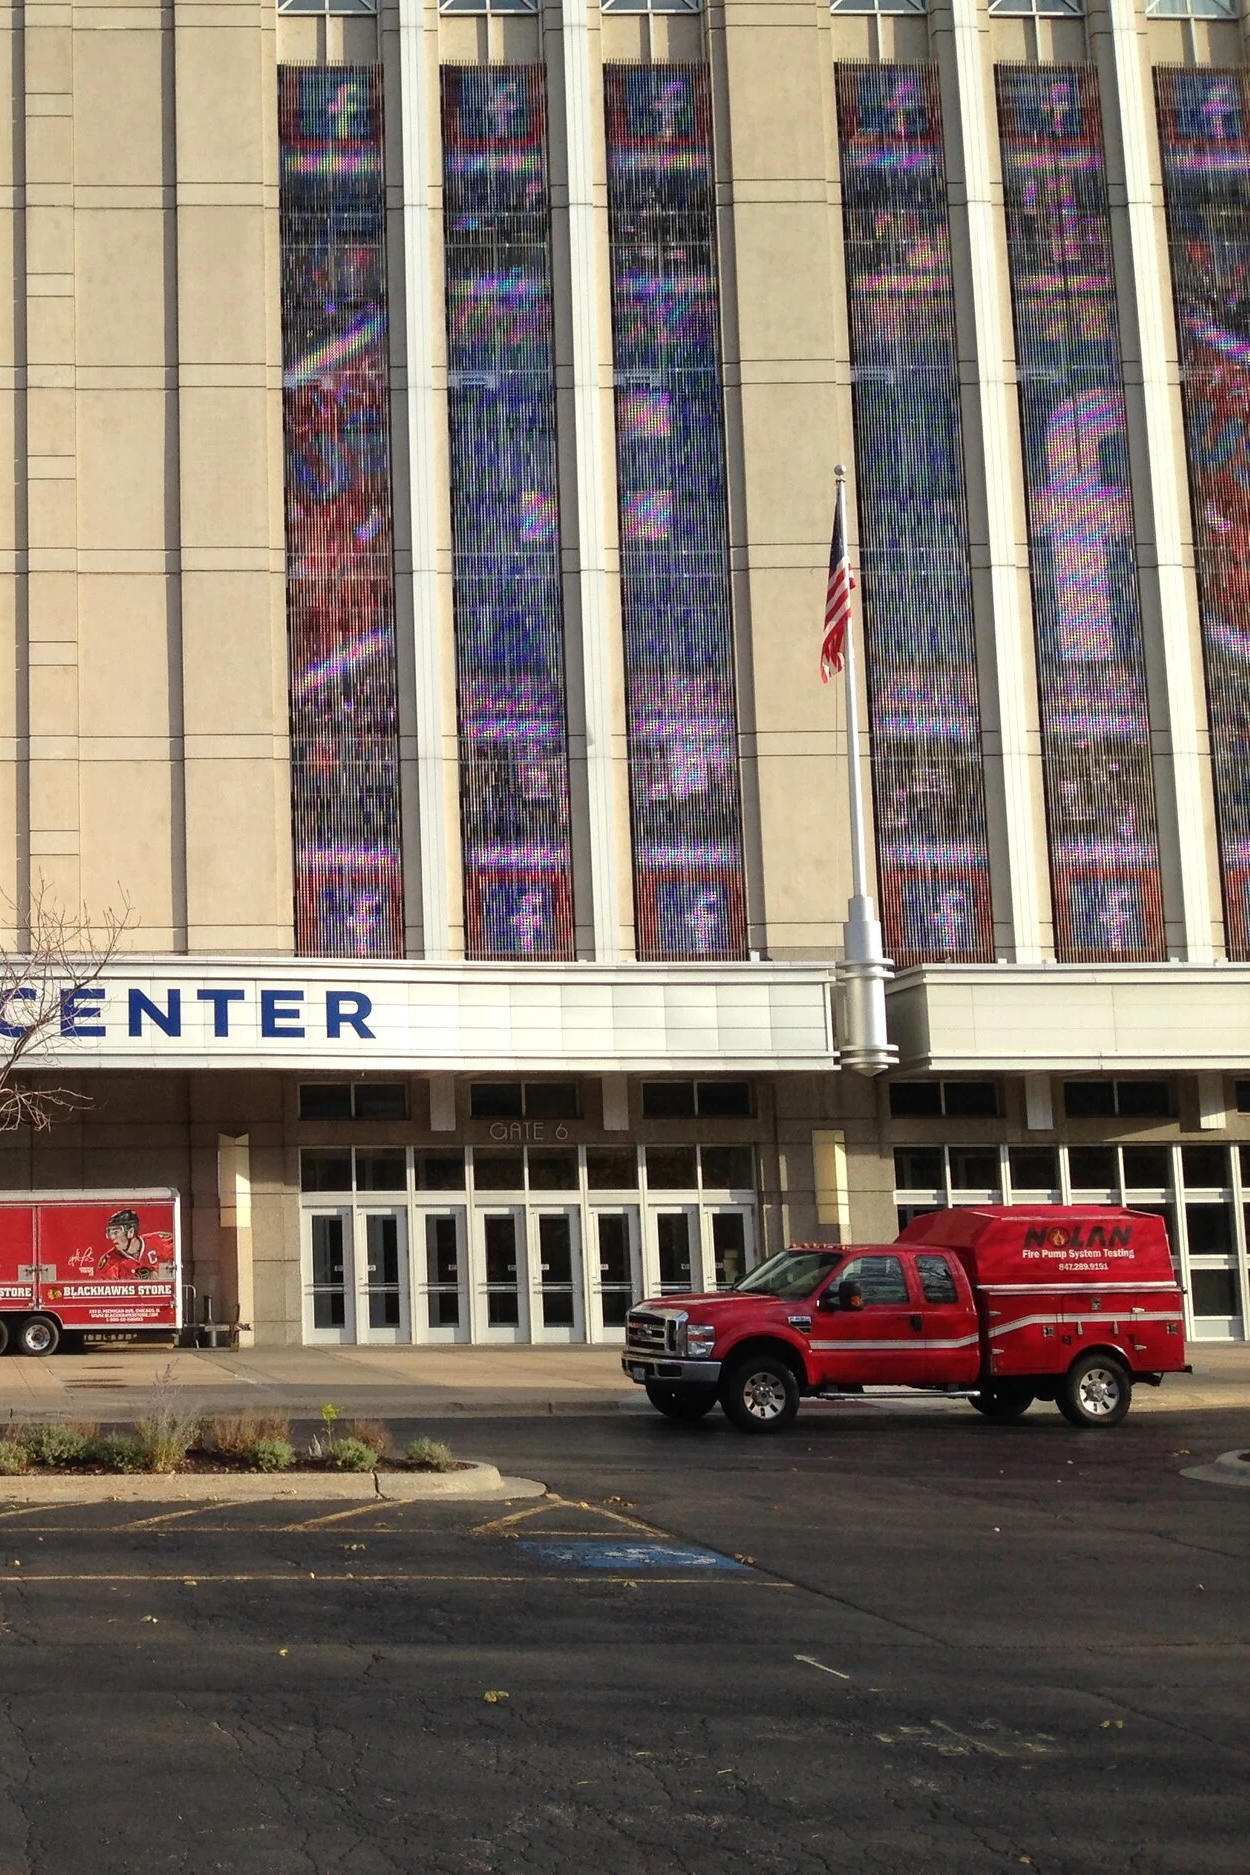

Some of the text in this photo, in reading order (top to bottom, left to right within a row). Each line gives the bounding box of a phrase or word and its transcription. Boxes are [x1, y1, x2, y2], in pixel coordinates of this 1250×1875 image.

[490, 1122, 569, 1140] GATE 6
[1023, 1225, 1133, 1248] NOLAN
[1022, 1248, 1135, 1259] Fire Pump System Testing
[63, 1285, 171, 1296] BLACKHAWKS STORE
